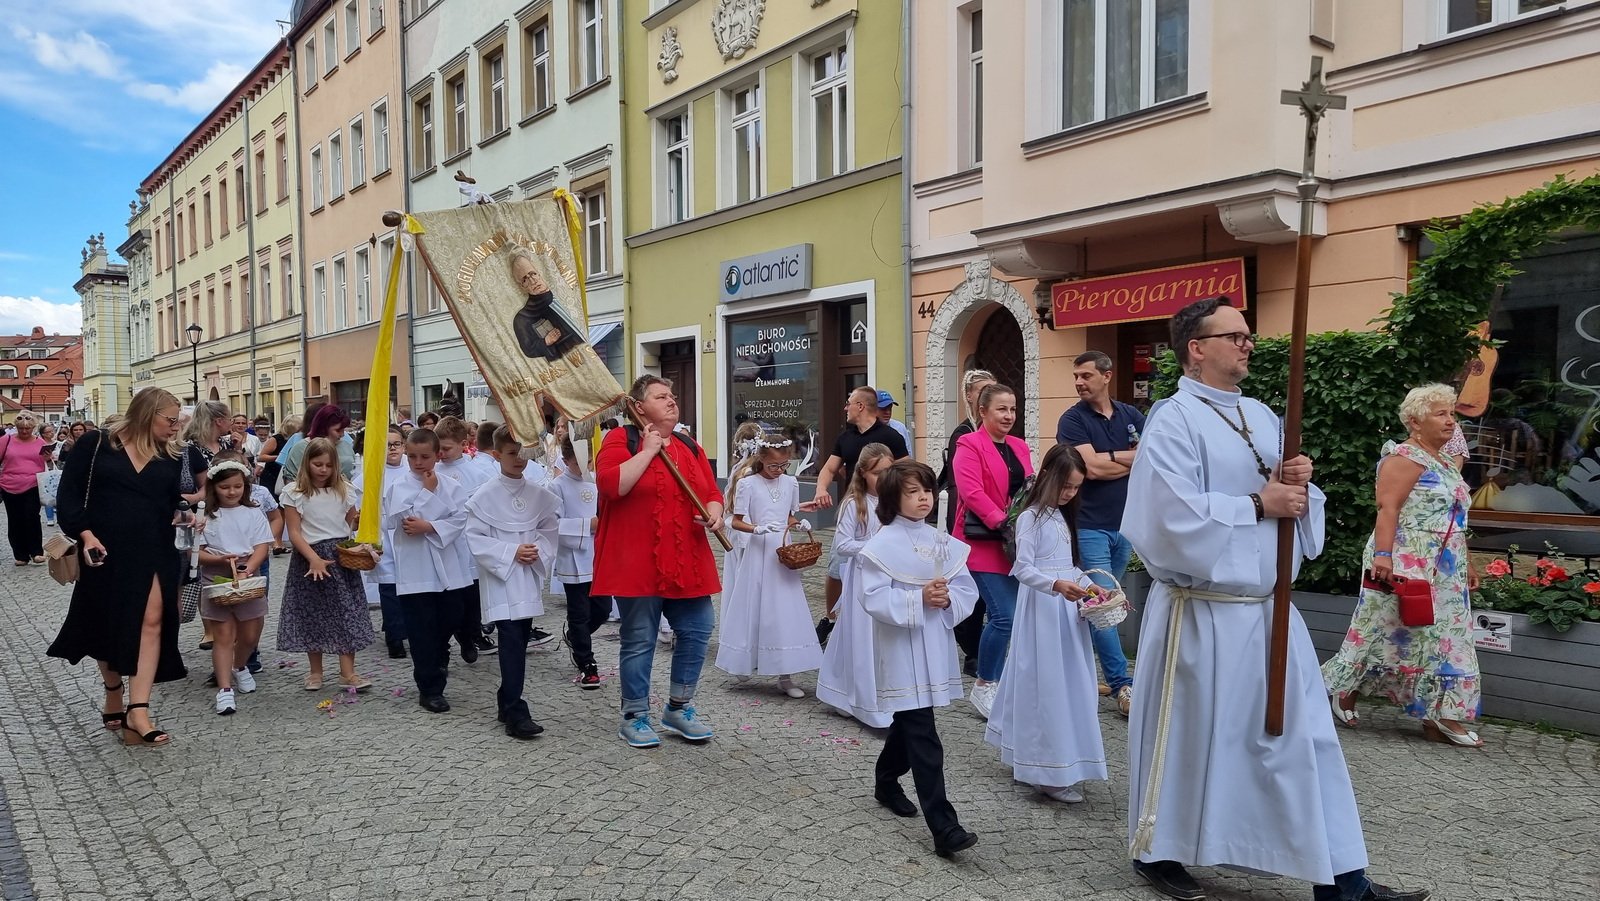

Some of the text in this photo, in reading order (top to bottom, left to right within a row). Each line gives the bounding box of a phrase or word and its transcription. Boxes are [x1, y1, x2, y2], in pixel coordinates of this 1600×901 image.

[743, 256, 798, 285] atlantic
[1056, 268, 1240, 314] Pierogarnia
[918, 300, 935, 318] 44
[758, 327, 786, 340] BIURO
[736, 336, 811, 357] NIERUCHOMOŚCI
[781, 398, 803, 407] ZAKUP
[747, 409, 800, 418] NIERUCHOMOŚCI
